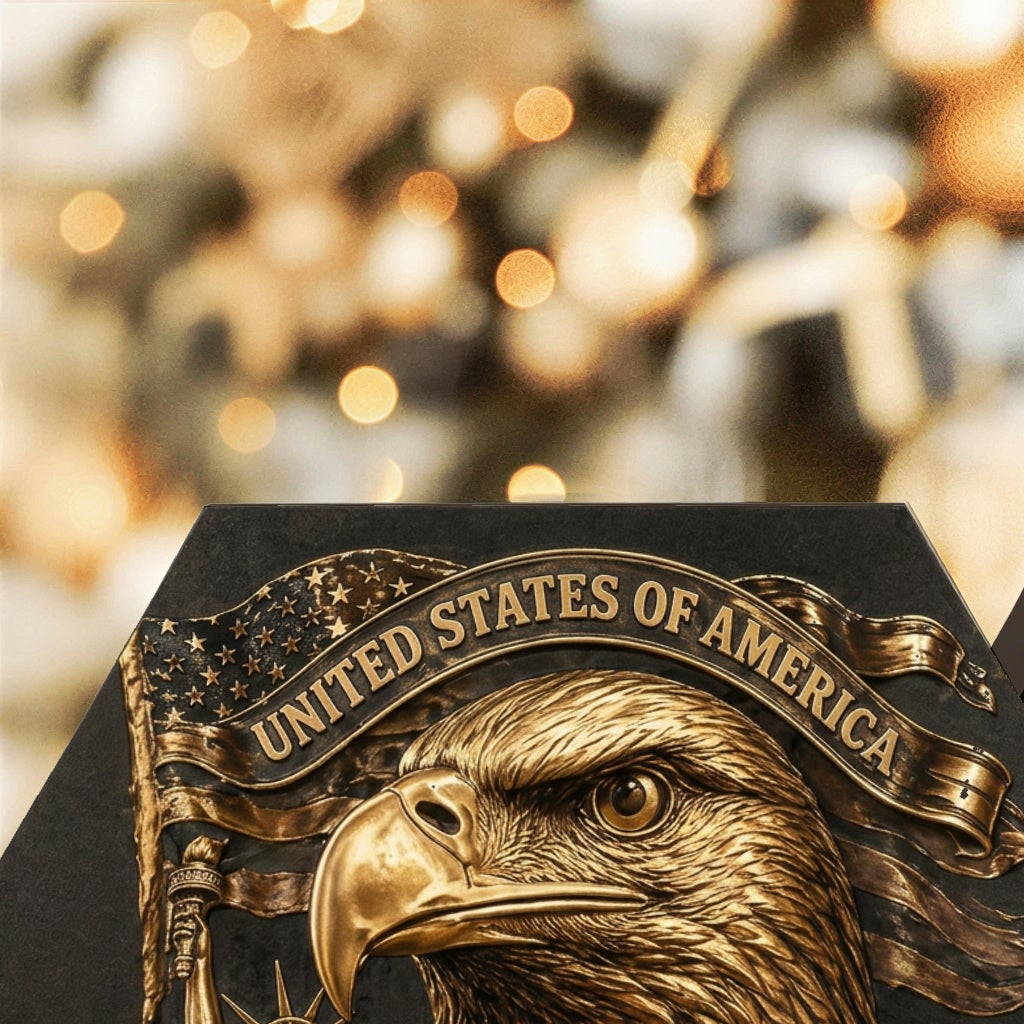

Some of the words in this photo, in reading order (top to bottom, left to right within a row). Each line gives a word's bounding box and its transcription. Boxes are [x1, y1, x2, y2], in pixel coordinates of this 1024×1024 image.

[251, 623, 423, 761] UNITED
[430, 572, 619, 649] STATES
[632, 579, 699, 634] OF
[700, 605, 901, 778] AMERICA
